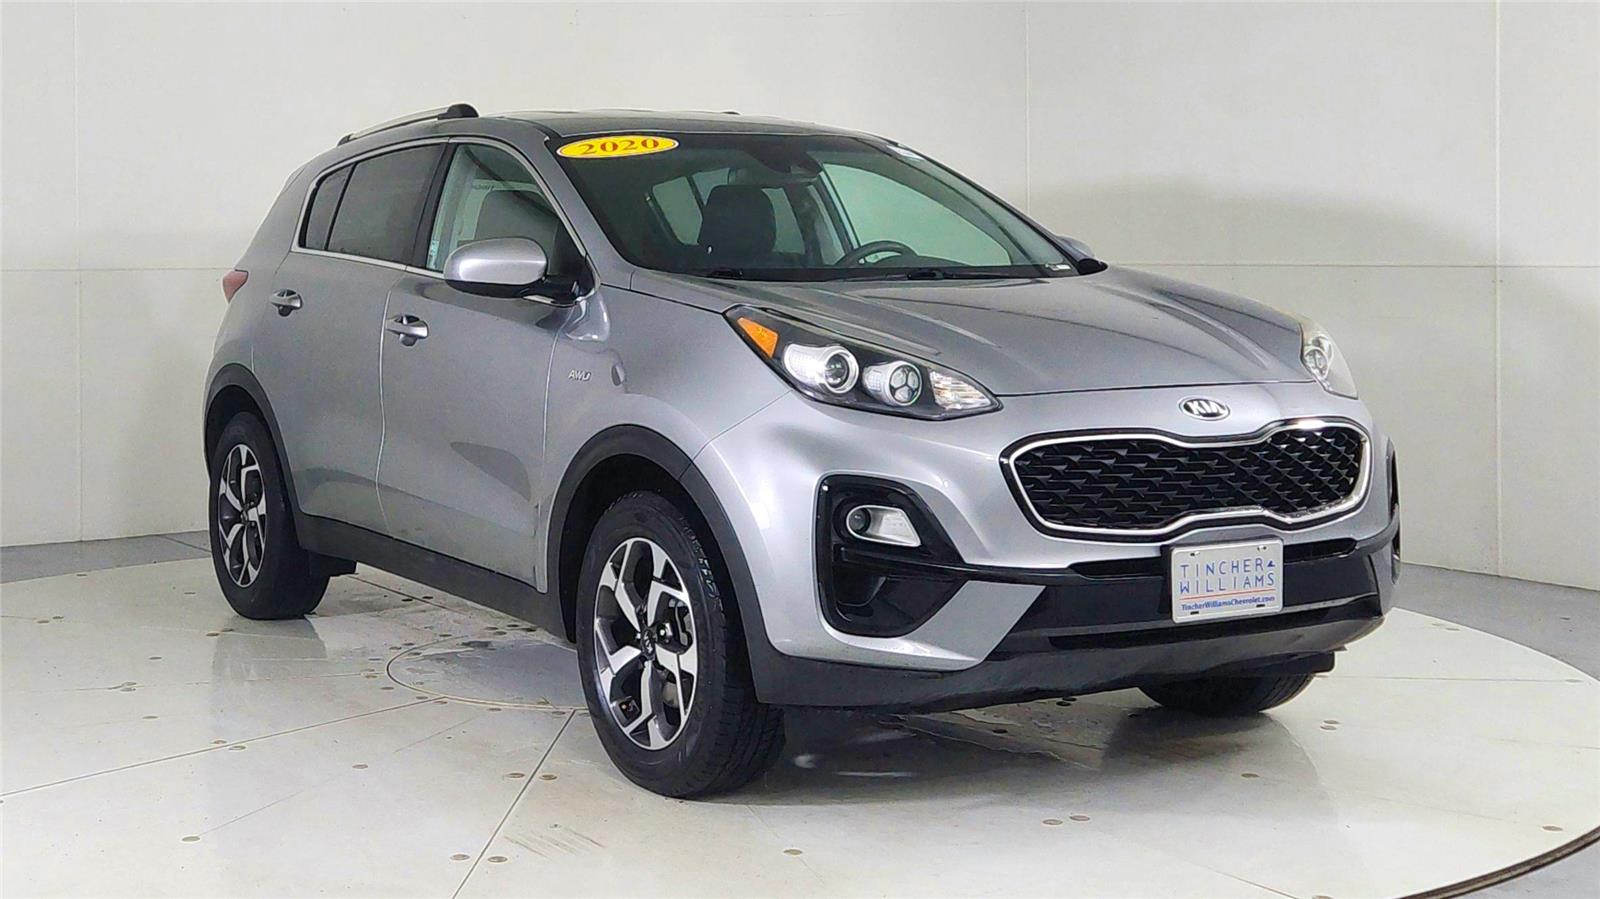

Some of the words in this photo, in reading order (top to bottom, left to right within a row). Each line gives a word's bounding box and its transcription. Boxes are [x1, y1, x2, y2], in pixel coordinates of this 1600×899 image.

[580, 139, 660, 155] 2020
[569, 370, 592, 382] AWD
[1180, 557, 1264, 578] TINCHER
[1180, 572, 1275, 594] WILLIAMS
[1182, 596, 1275, 611] TincherWilliamsChevrolet.com
